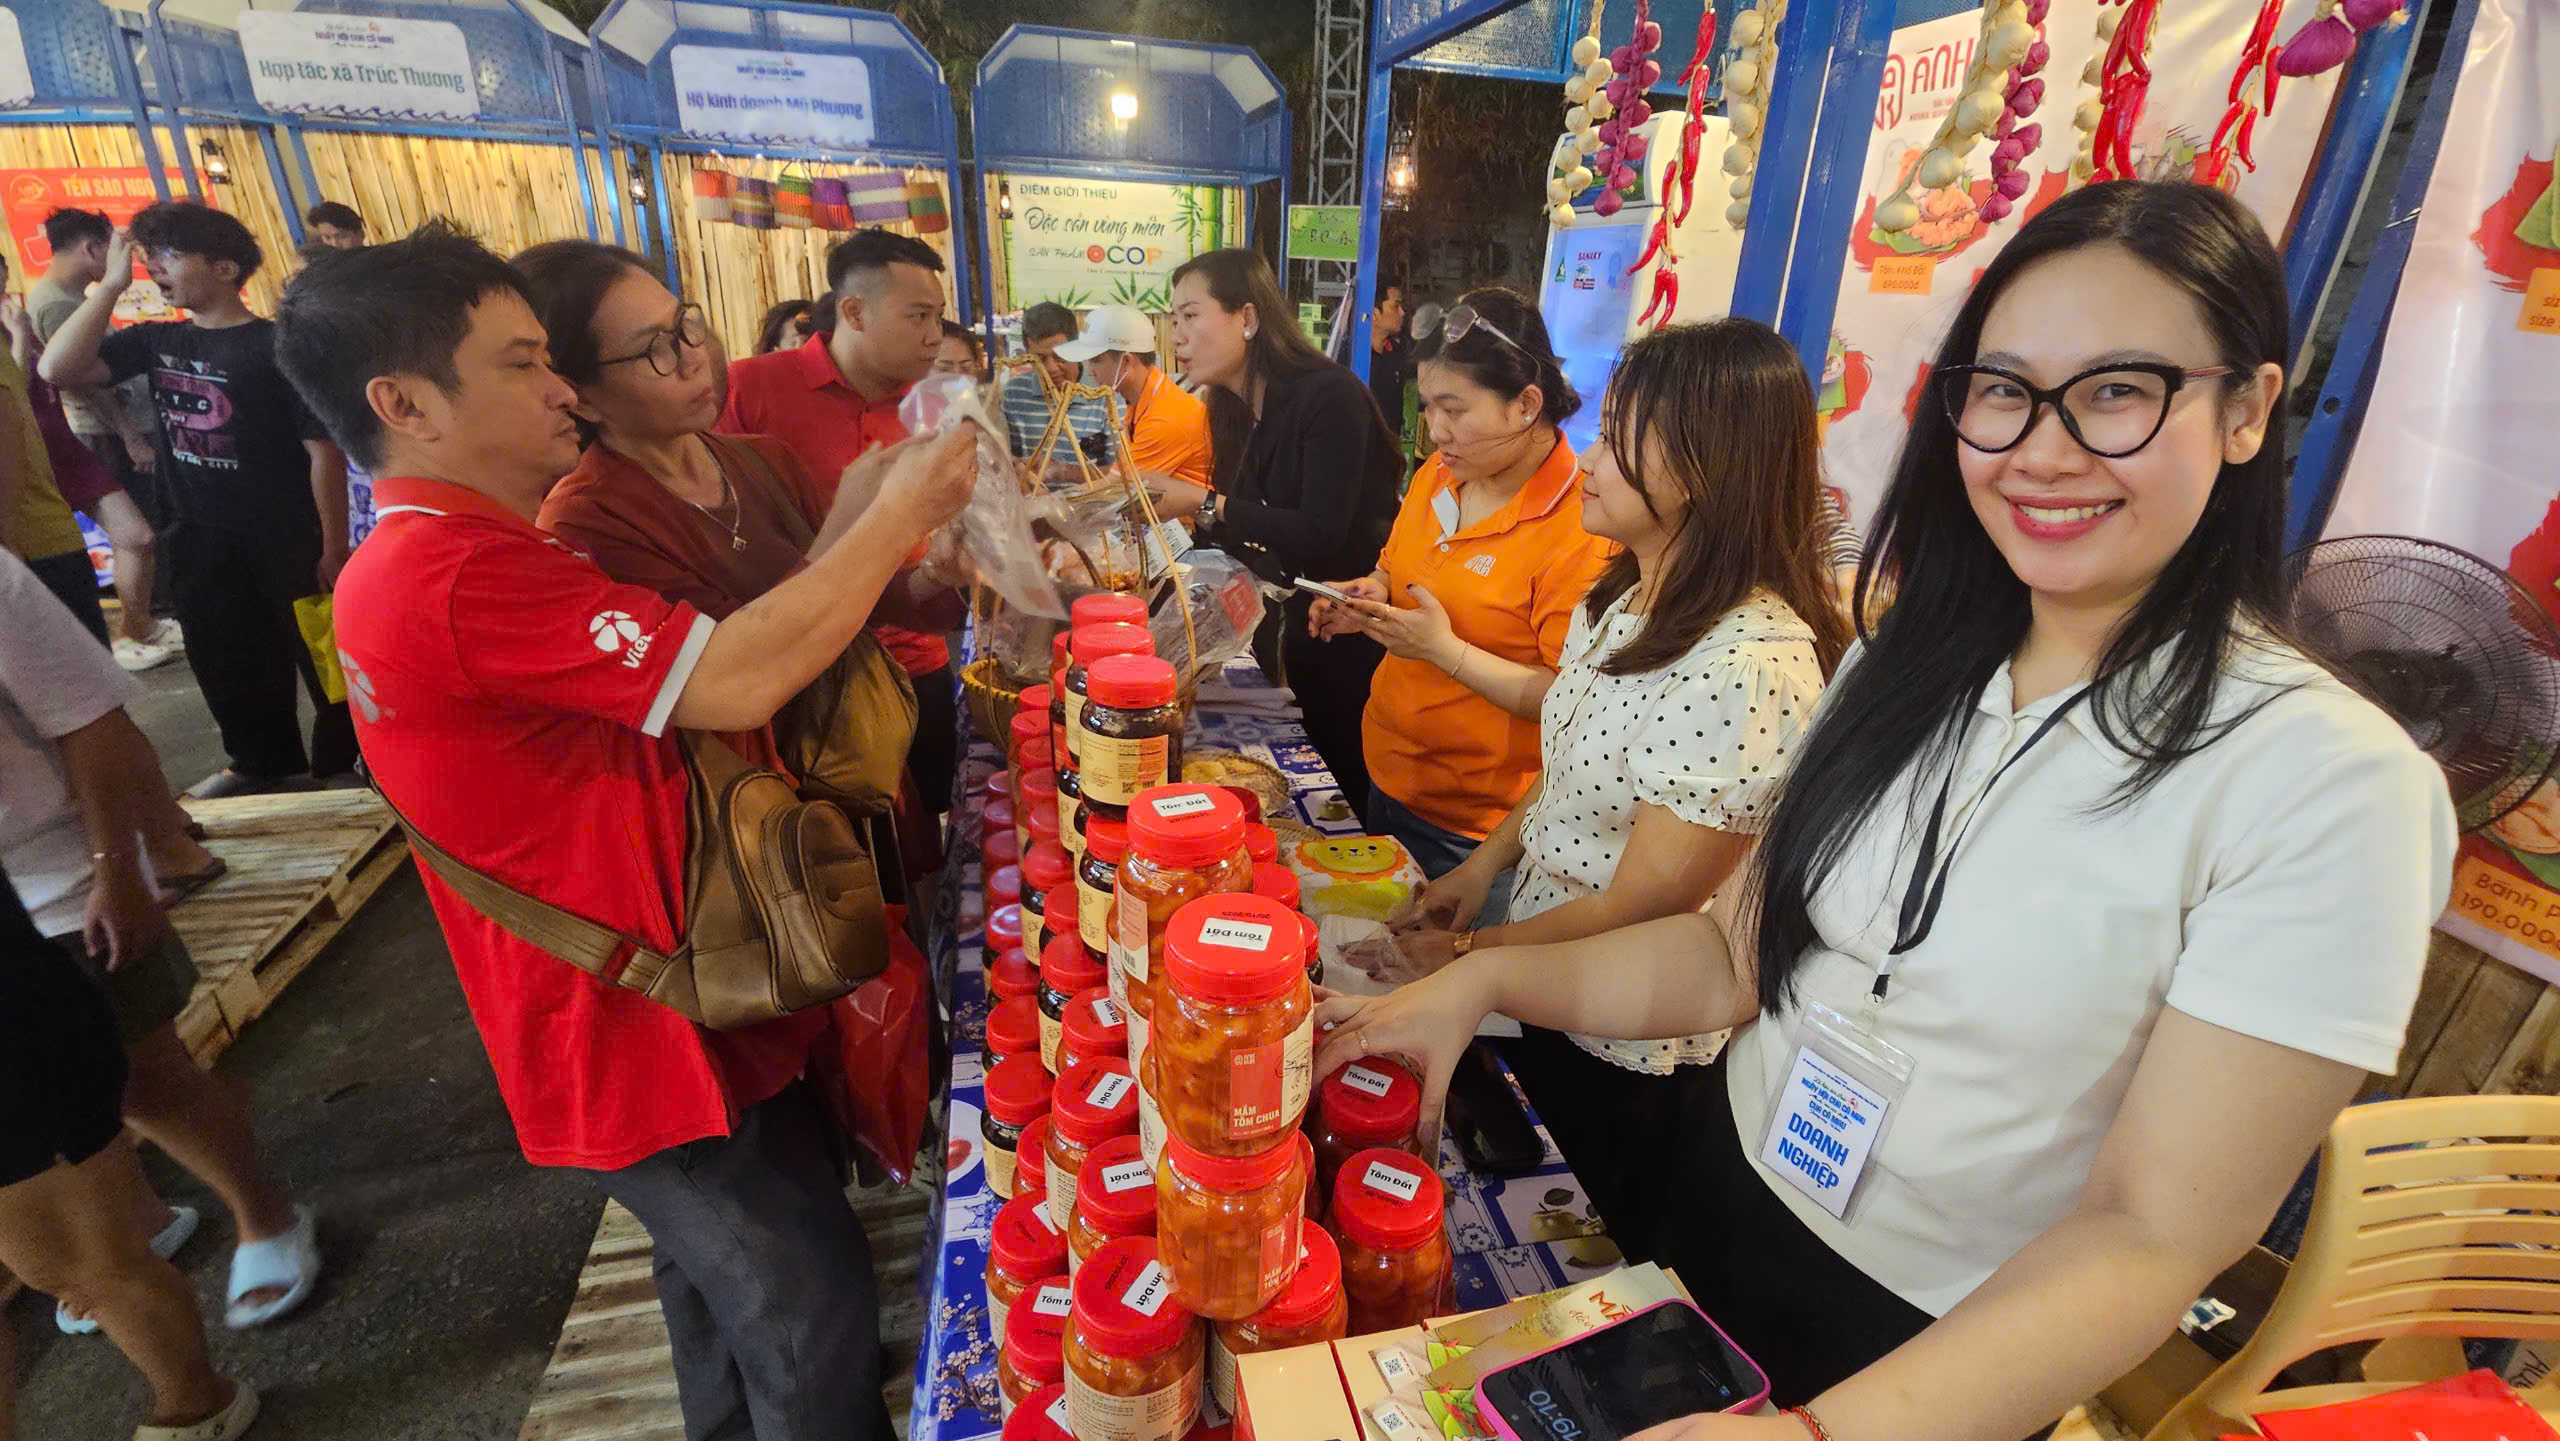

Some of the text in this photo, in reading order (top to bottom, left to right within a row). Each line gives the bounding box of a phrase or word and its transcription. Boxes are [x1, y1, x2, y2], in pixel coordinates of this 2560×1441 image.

[707, 92, 737, 109] kinh
[1087, 245, 1163, 265] OCOP
[2459, 891, 2560, 951] 190.000
[1234, 931, 1264, 942] Tôm
[1347, 1070, 1386, 1089] Tôm Đất
[1787, 1112, 1850, 1167] DOANH
[1777, 1136, 1840, 1190] NGHIỆP
[1370, 1168, 1413, 1191] Tôm Đất
[1041, 1295, 1063, 1305] Tôm
[1528, 1390, 1582, 1441] 19:10
